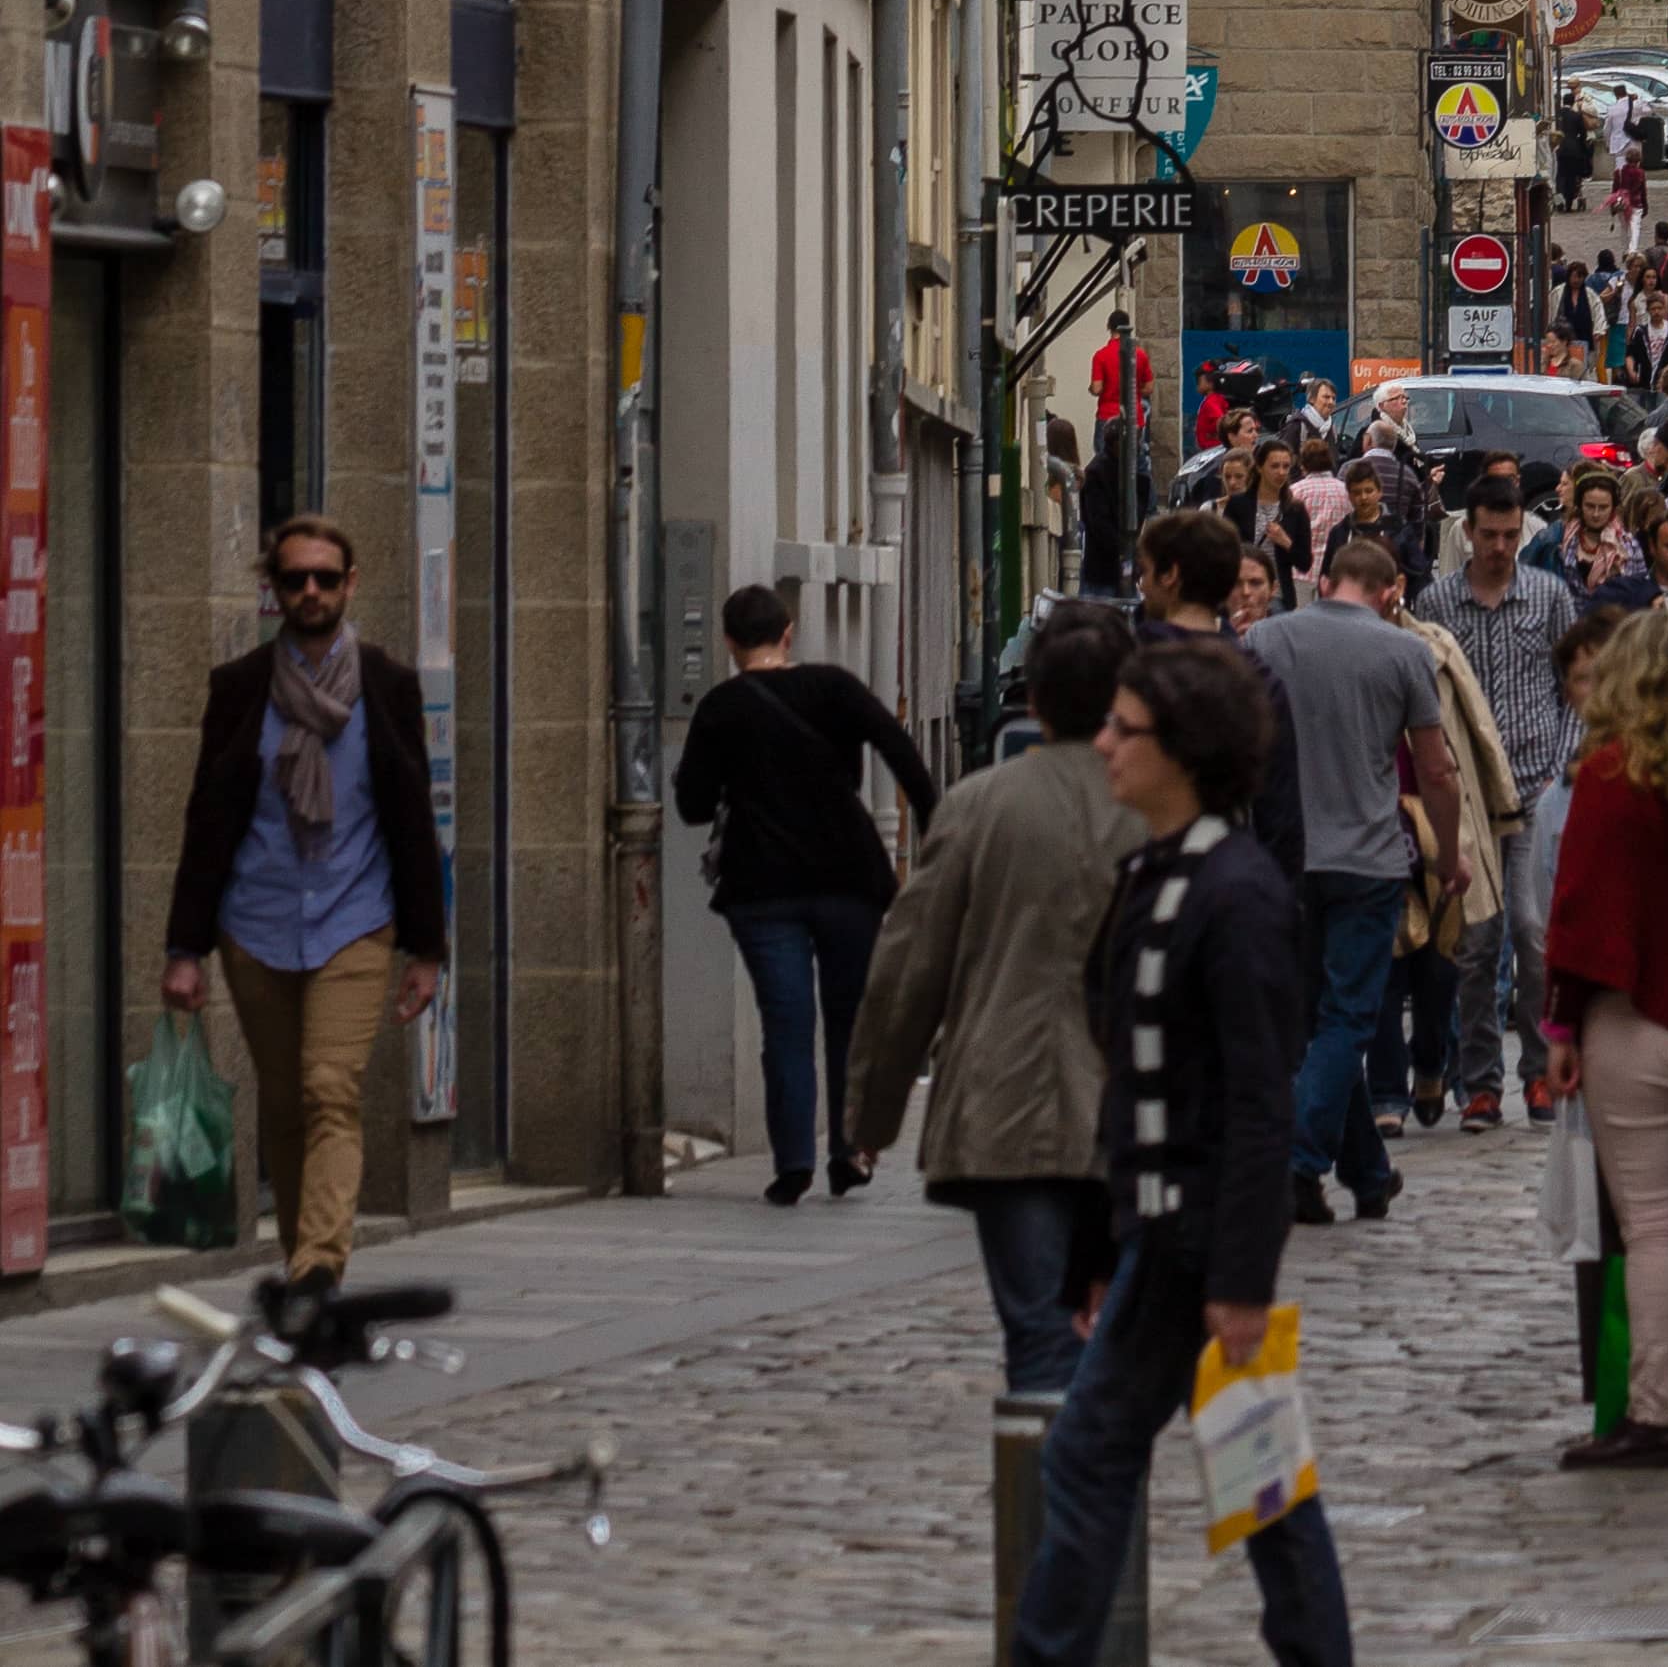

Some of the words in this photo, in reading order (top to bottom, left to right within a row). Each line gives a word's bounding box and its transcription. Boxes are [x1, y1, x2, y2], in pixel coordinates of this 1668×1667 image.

[1039, 3, 1182, 25] PATRICE
[1012, 193, 1193, 228] CREPERIE
[1464, 309, 1499, 322] SAUF
[1354, 366, 1371, 378] Un
